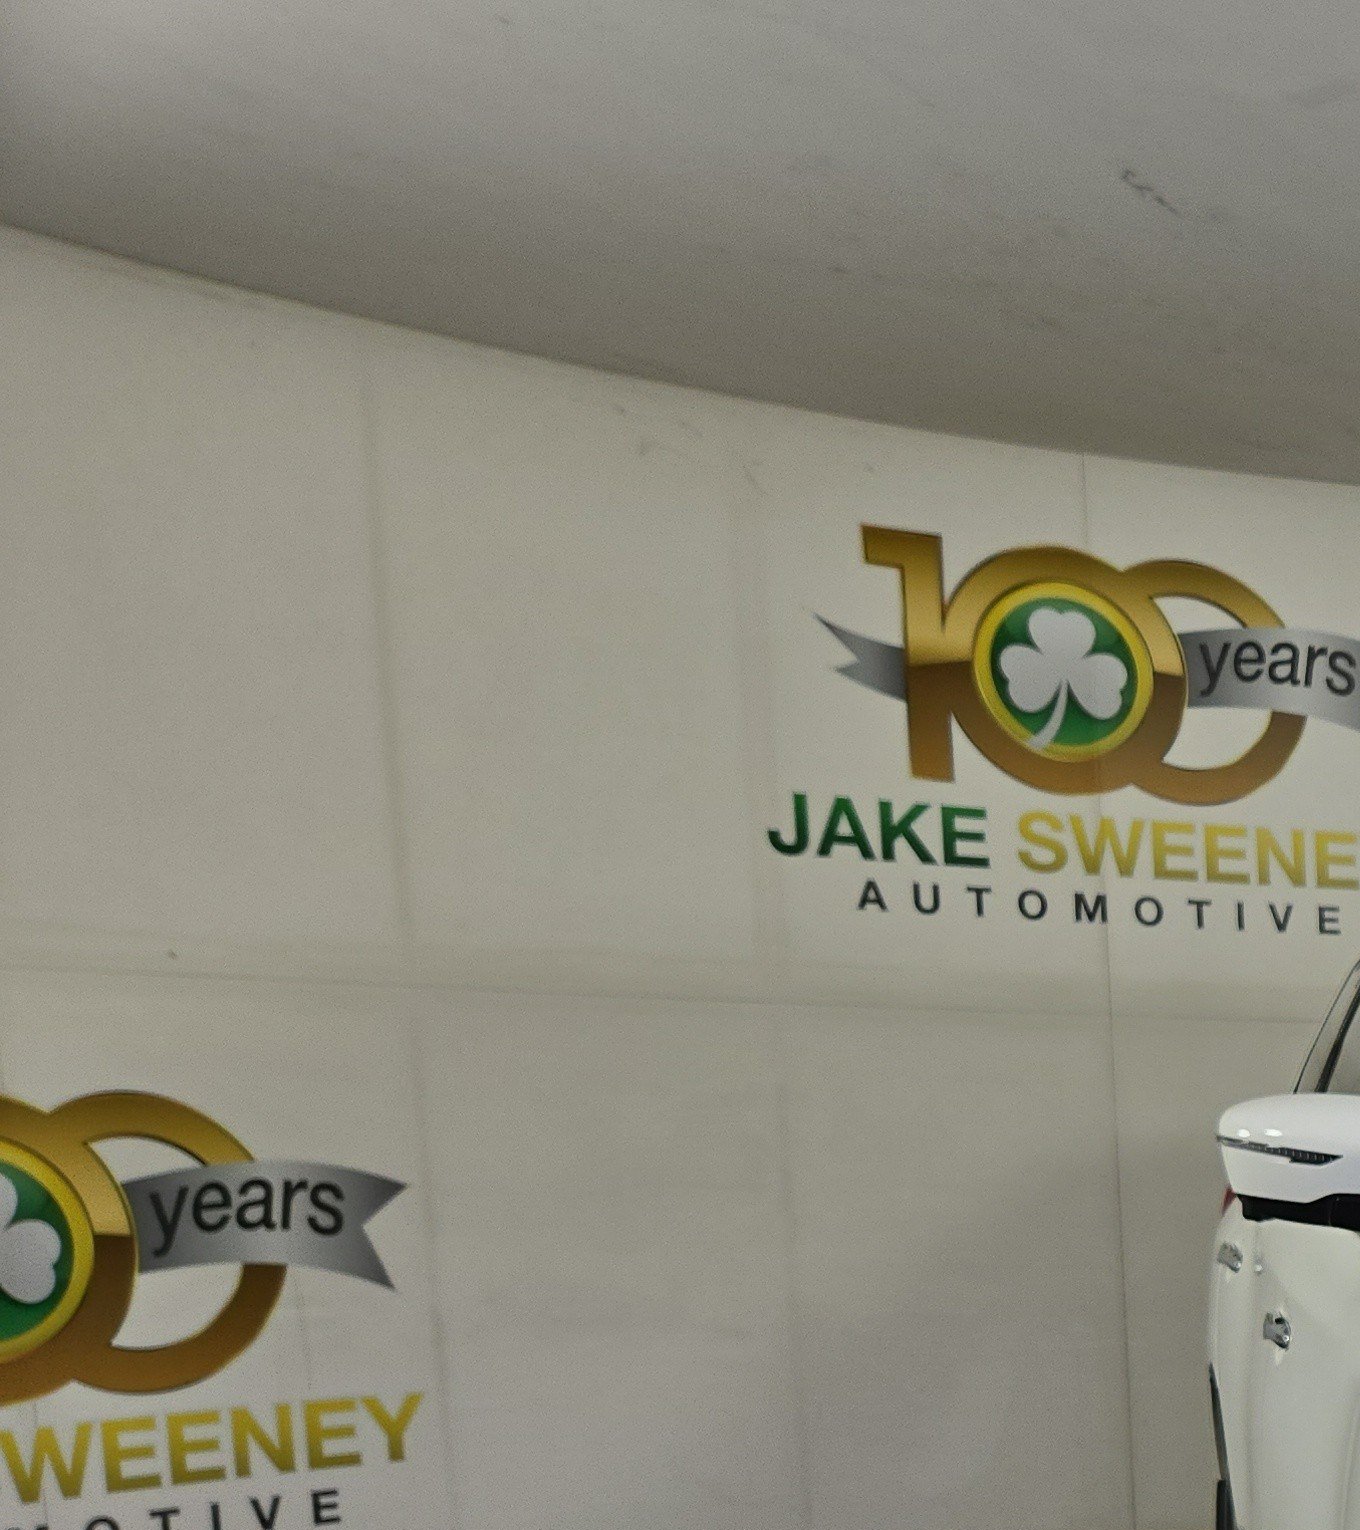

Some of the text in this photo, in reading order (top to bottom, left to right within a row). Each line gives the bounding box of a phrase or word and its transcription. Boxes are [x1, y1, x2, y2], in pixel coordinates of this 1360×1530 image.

[1199, 638, 1357, 697] years
[767, 792, 991, 869] JAKE
[857, 880, 1342, 935] AUTOMOTIVE
[150, 1177, 346, 1258] years
